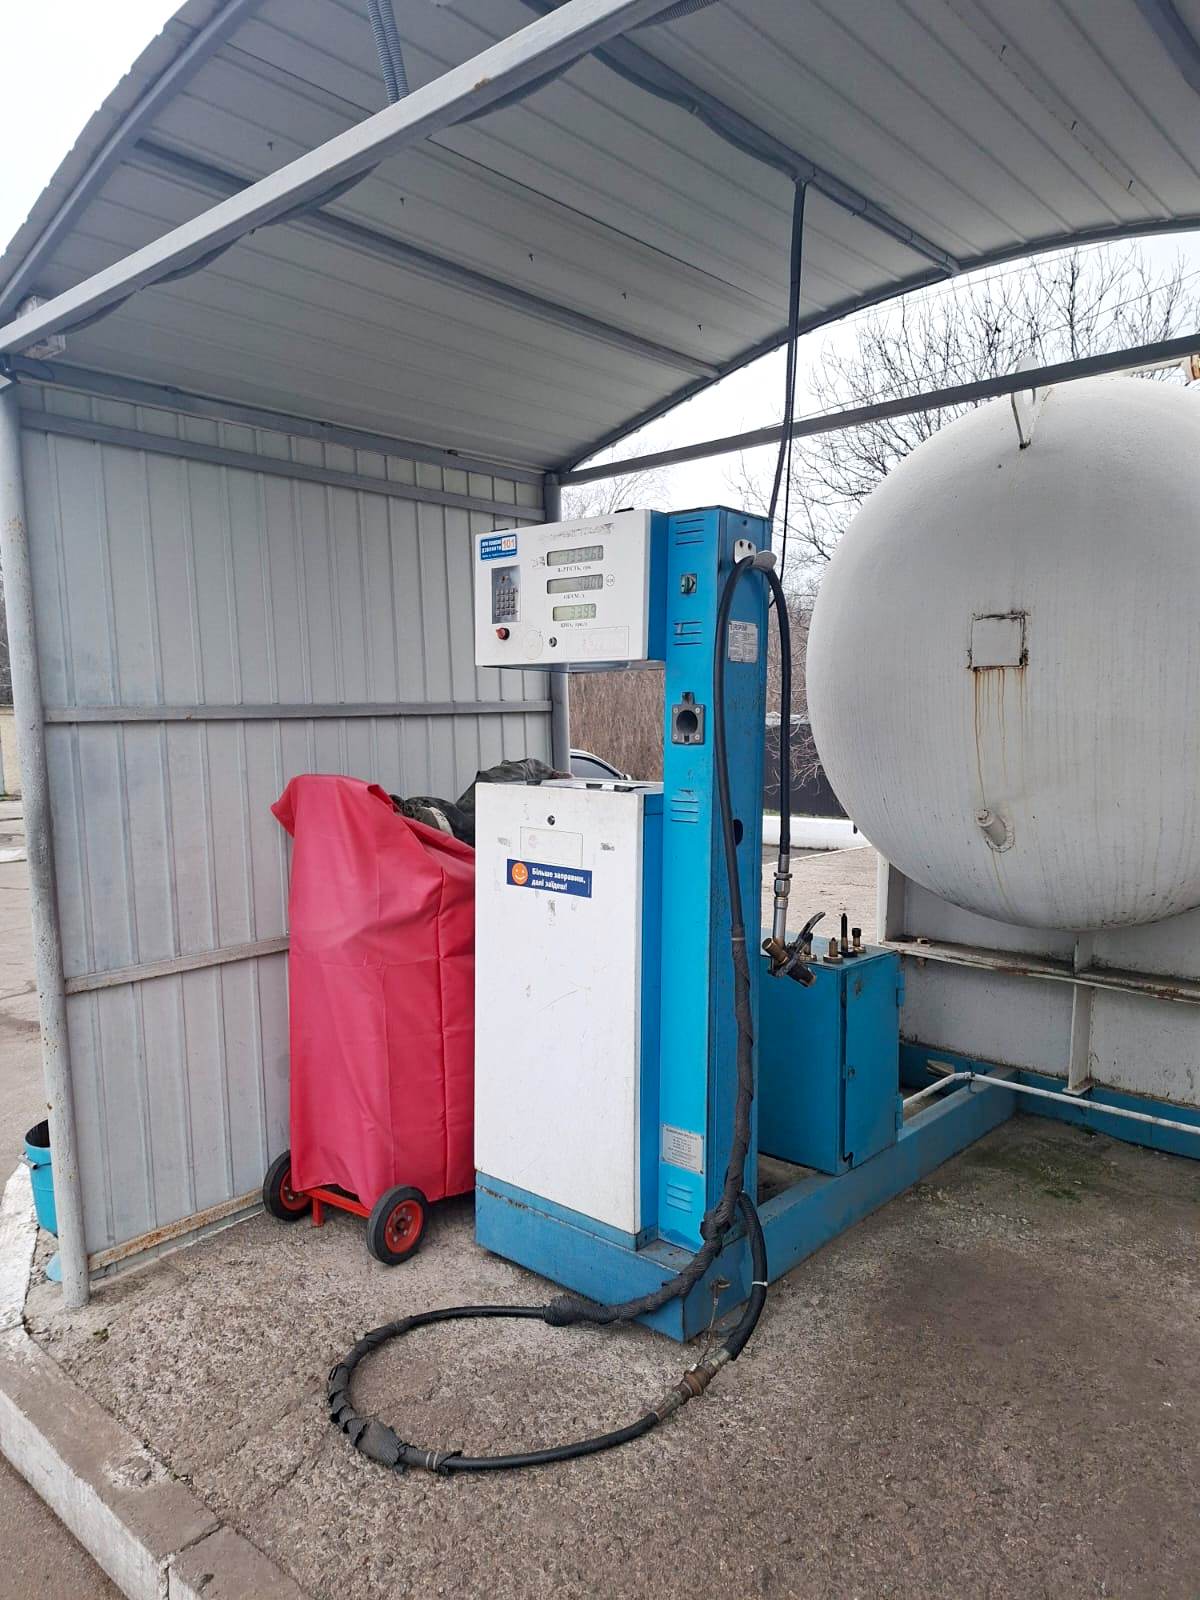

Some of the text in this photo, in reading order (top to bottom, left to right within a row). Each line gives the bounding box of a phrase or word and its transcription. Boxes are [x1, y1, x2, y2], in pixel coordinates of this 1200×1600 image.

[503, 539, 515, 550] 101
[532, 868, 553, 878] Більше
[532, 879, 545, 888] далі
